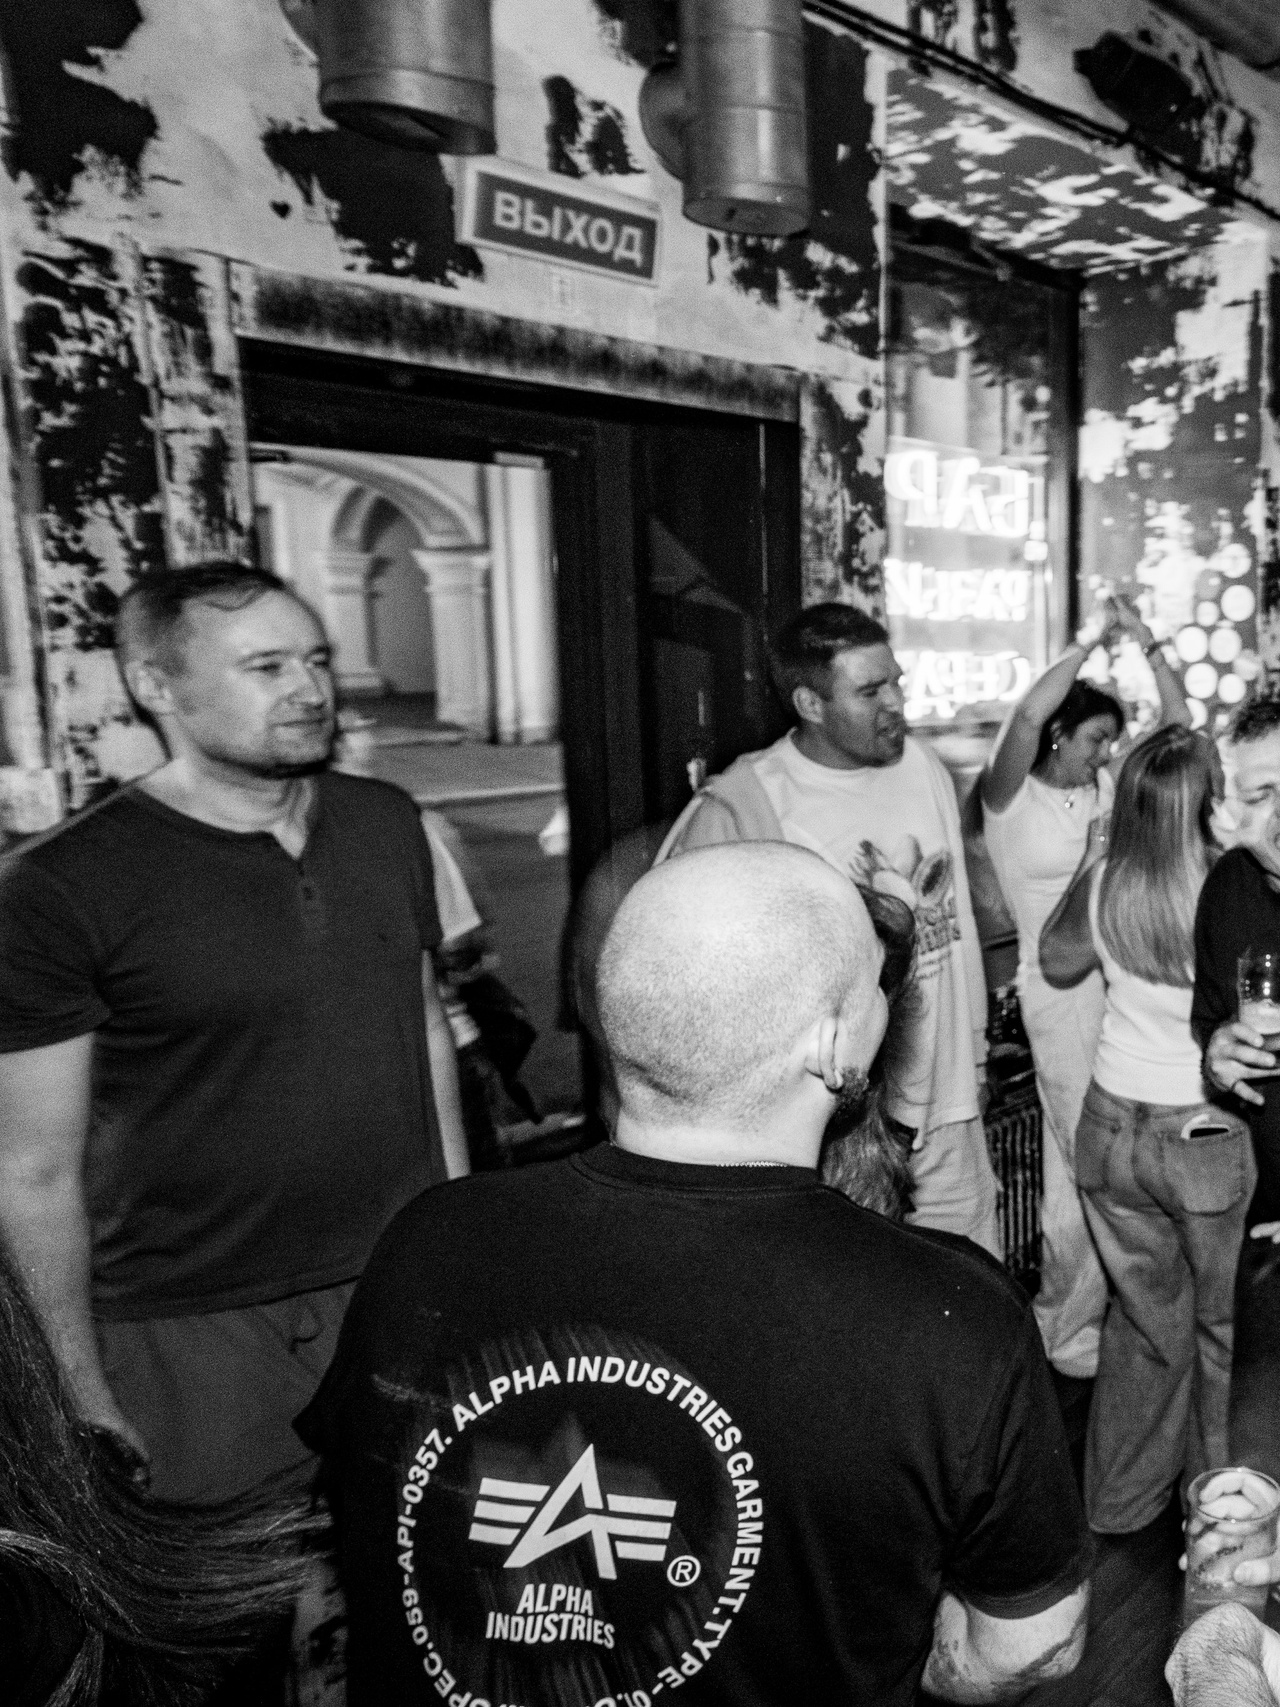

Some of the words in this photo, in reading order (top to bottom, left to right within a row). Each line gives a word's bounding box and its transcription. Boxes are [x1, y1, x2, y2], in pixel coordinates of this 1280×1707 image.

[493, 190, 643, 267] ВЫХОД
[452, 1361, 561, 1432] ALPHA
[567, 1356, 742, 1452] INDUSTRIES
[516, 1584, 593, 1617] ALPHA
[486, 1611, 615, 1649] INDUSTRIES
